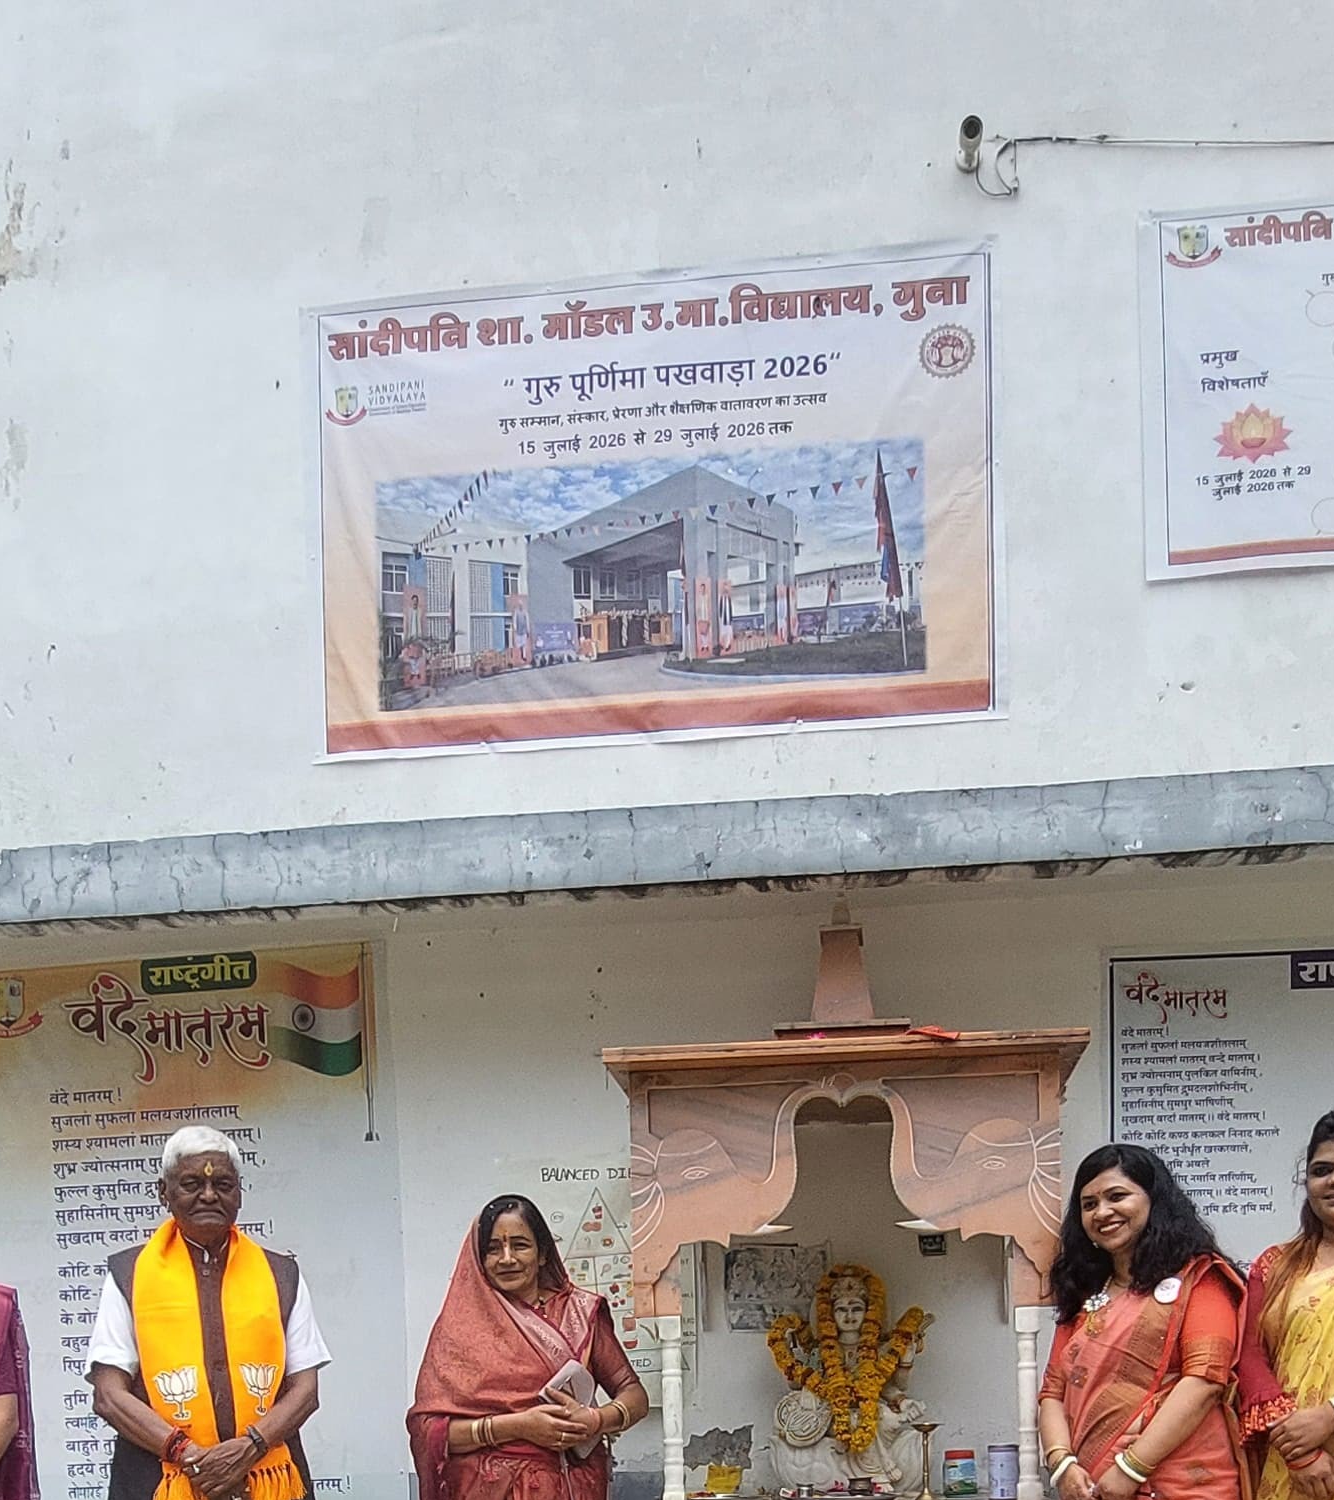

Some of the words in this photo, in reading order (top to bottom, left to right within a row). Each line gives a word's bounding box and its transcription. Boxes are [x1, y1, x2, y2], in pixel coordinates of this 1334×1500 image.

[477, 315, 533, 348] शा.
[541, 300, 634, 341] मॉडल
[1200, 350, 1239, 368] प्रमुख
[368, 379, 424, 395] SANDIPANI
[523, 375, 562, 404] गुरु
[569, 362, 646, 400] पूर्णिमा
[654, 358, 754, 389] पखवाड़ा
[368, 392, 425, 406] VIDYALAYA
[519, 415, 563, 429] सम्मान,
[567, 407, 609, 425] संस्कार,
[612, 405, 642, 421] प्रेरणा
[645, 401, 666, 417] और
[669, 399, 717, 415] शैक्षणिक
[720, 396, 772, 411] वातावरण
[775, 394, 791, 407] का
[793, 392, 827, 406] उत्सव
[518, 441, 535, 455] 15
[543, 435, 582, 459] जुलाई
[589, 433, 626, 449] 2026
[634, 428, 647, 445] से
[654, 429, 672, 443] 29
[680, 422, 719, 448] जुलाई
[728, 421, 765, 438] 2026
[768, 420, 793, 435] तक
[1196, 476, 1209, 486] 15
[1215, 470, 1243, 487] जुलाई
[1249, 468, 1276, 480] 2026
[1282, 465, 1291, 477] से
[1298, 465, 1311, 476] 29
[1212, 484, 1242, 501] जुलाई
[1247, 483, 1274, 493] 2026
[1277, 480, 1295, 491] तक
[148, 954, 251, 989] राष्ट्रगीत
[50, 1087, 69, 1105] वंदे
[52, 1139, 81, 1152] शस्य
[86, 1131, 136, 1149] श्यामलां
[53, 1160, 78, 1180] शुभ्र
[541, 1167, 599, 1183] BALANCED
[54, 1182, 89, 1203] फुल्ल
[93, 1176, 142, 1201] कुसुमित
[55, 1202, 121, 1227] सुहासिनीम्
[123, 1205, 161, 1222] सुमधुर
[56, 1231, 106, 1249] सुखदाम्
[109, 1226, 139, 1244] वरदां
[58, 1260, 90, 1279] कोटि
[60, 1308, 74, 1326] के
[64, 1389, 88, 1411] तुमि
[67, 1458, 96, 1479] हृदये
